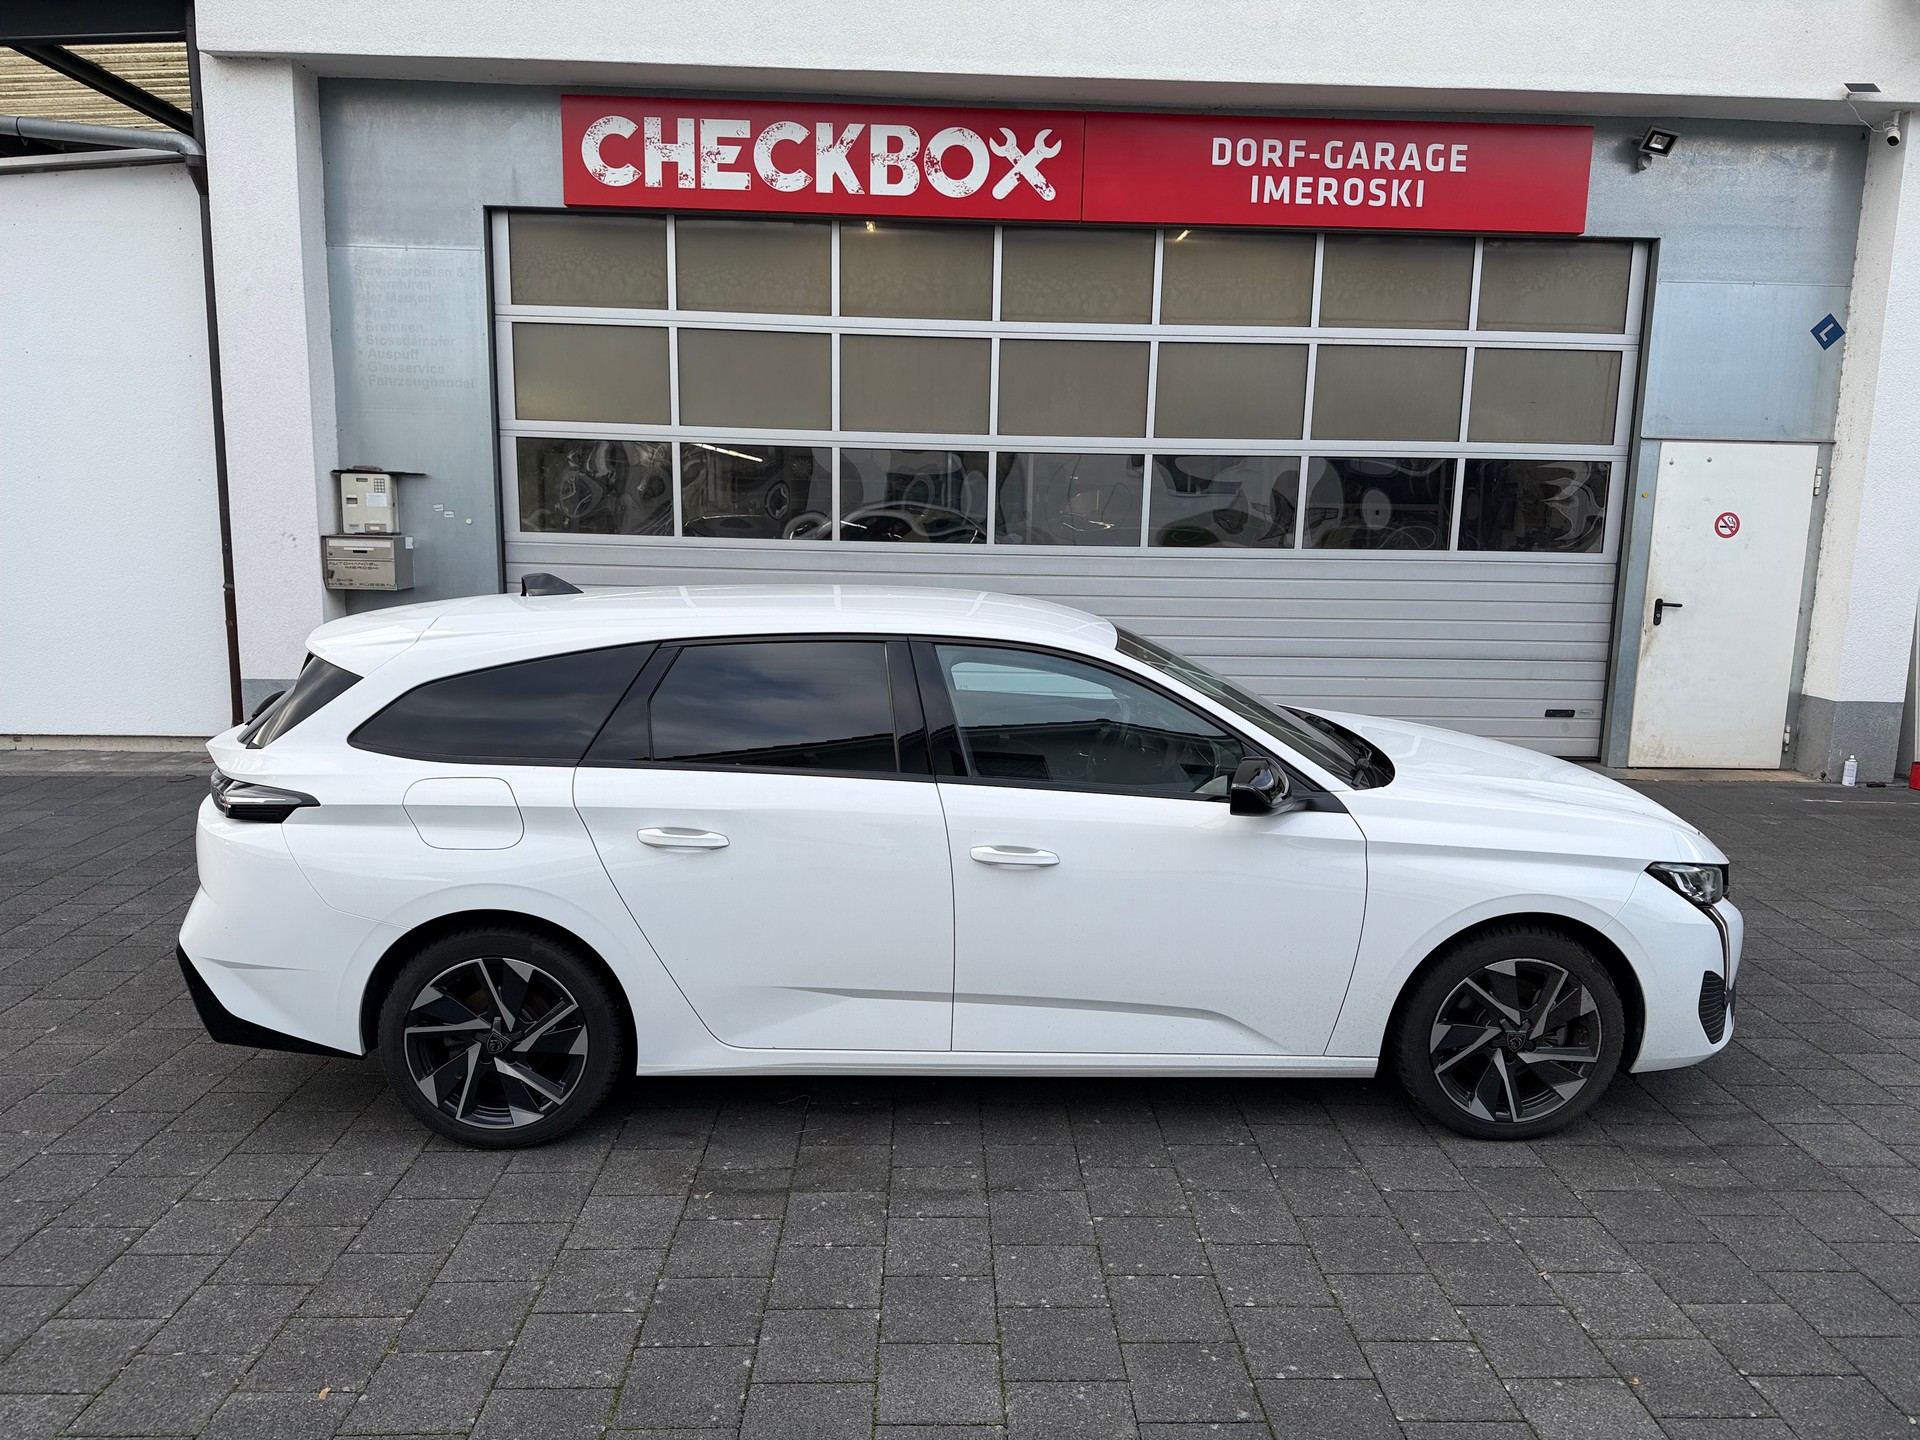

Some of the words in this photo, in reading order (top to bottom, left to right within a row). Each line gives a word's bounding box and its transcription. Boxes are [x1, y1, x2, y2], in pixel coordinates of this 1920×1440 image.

[1211, 136, 1469, 173] DORF-GARAGE
[1250, 174, 1425, 208] IMEROSKI
[368, 348, 419, 361] Auspuff
[368, 361, 445, 374] Glasservice
[368, 374, 475, 390] Fahrzeughandel
